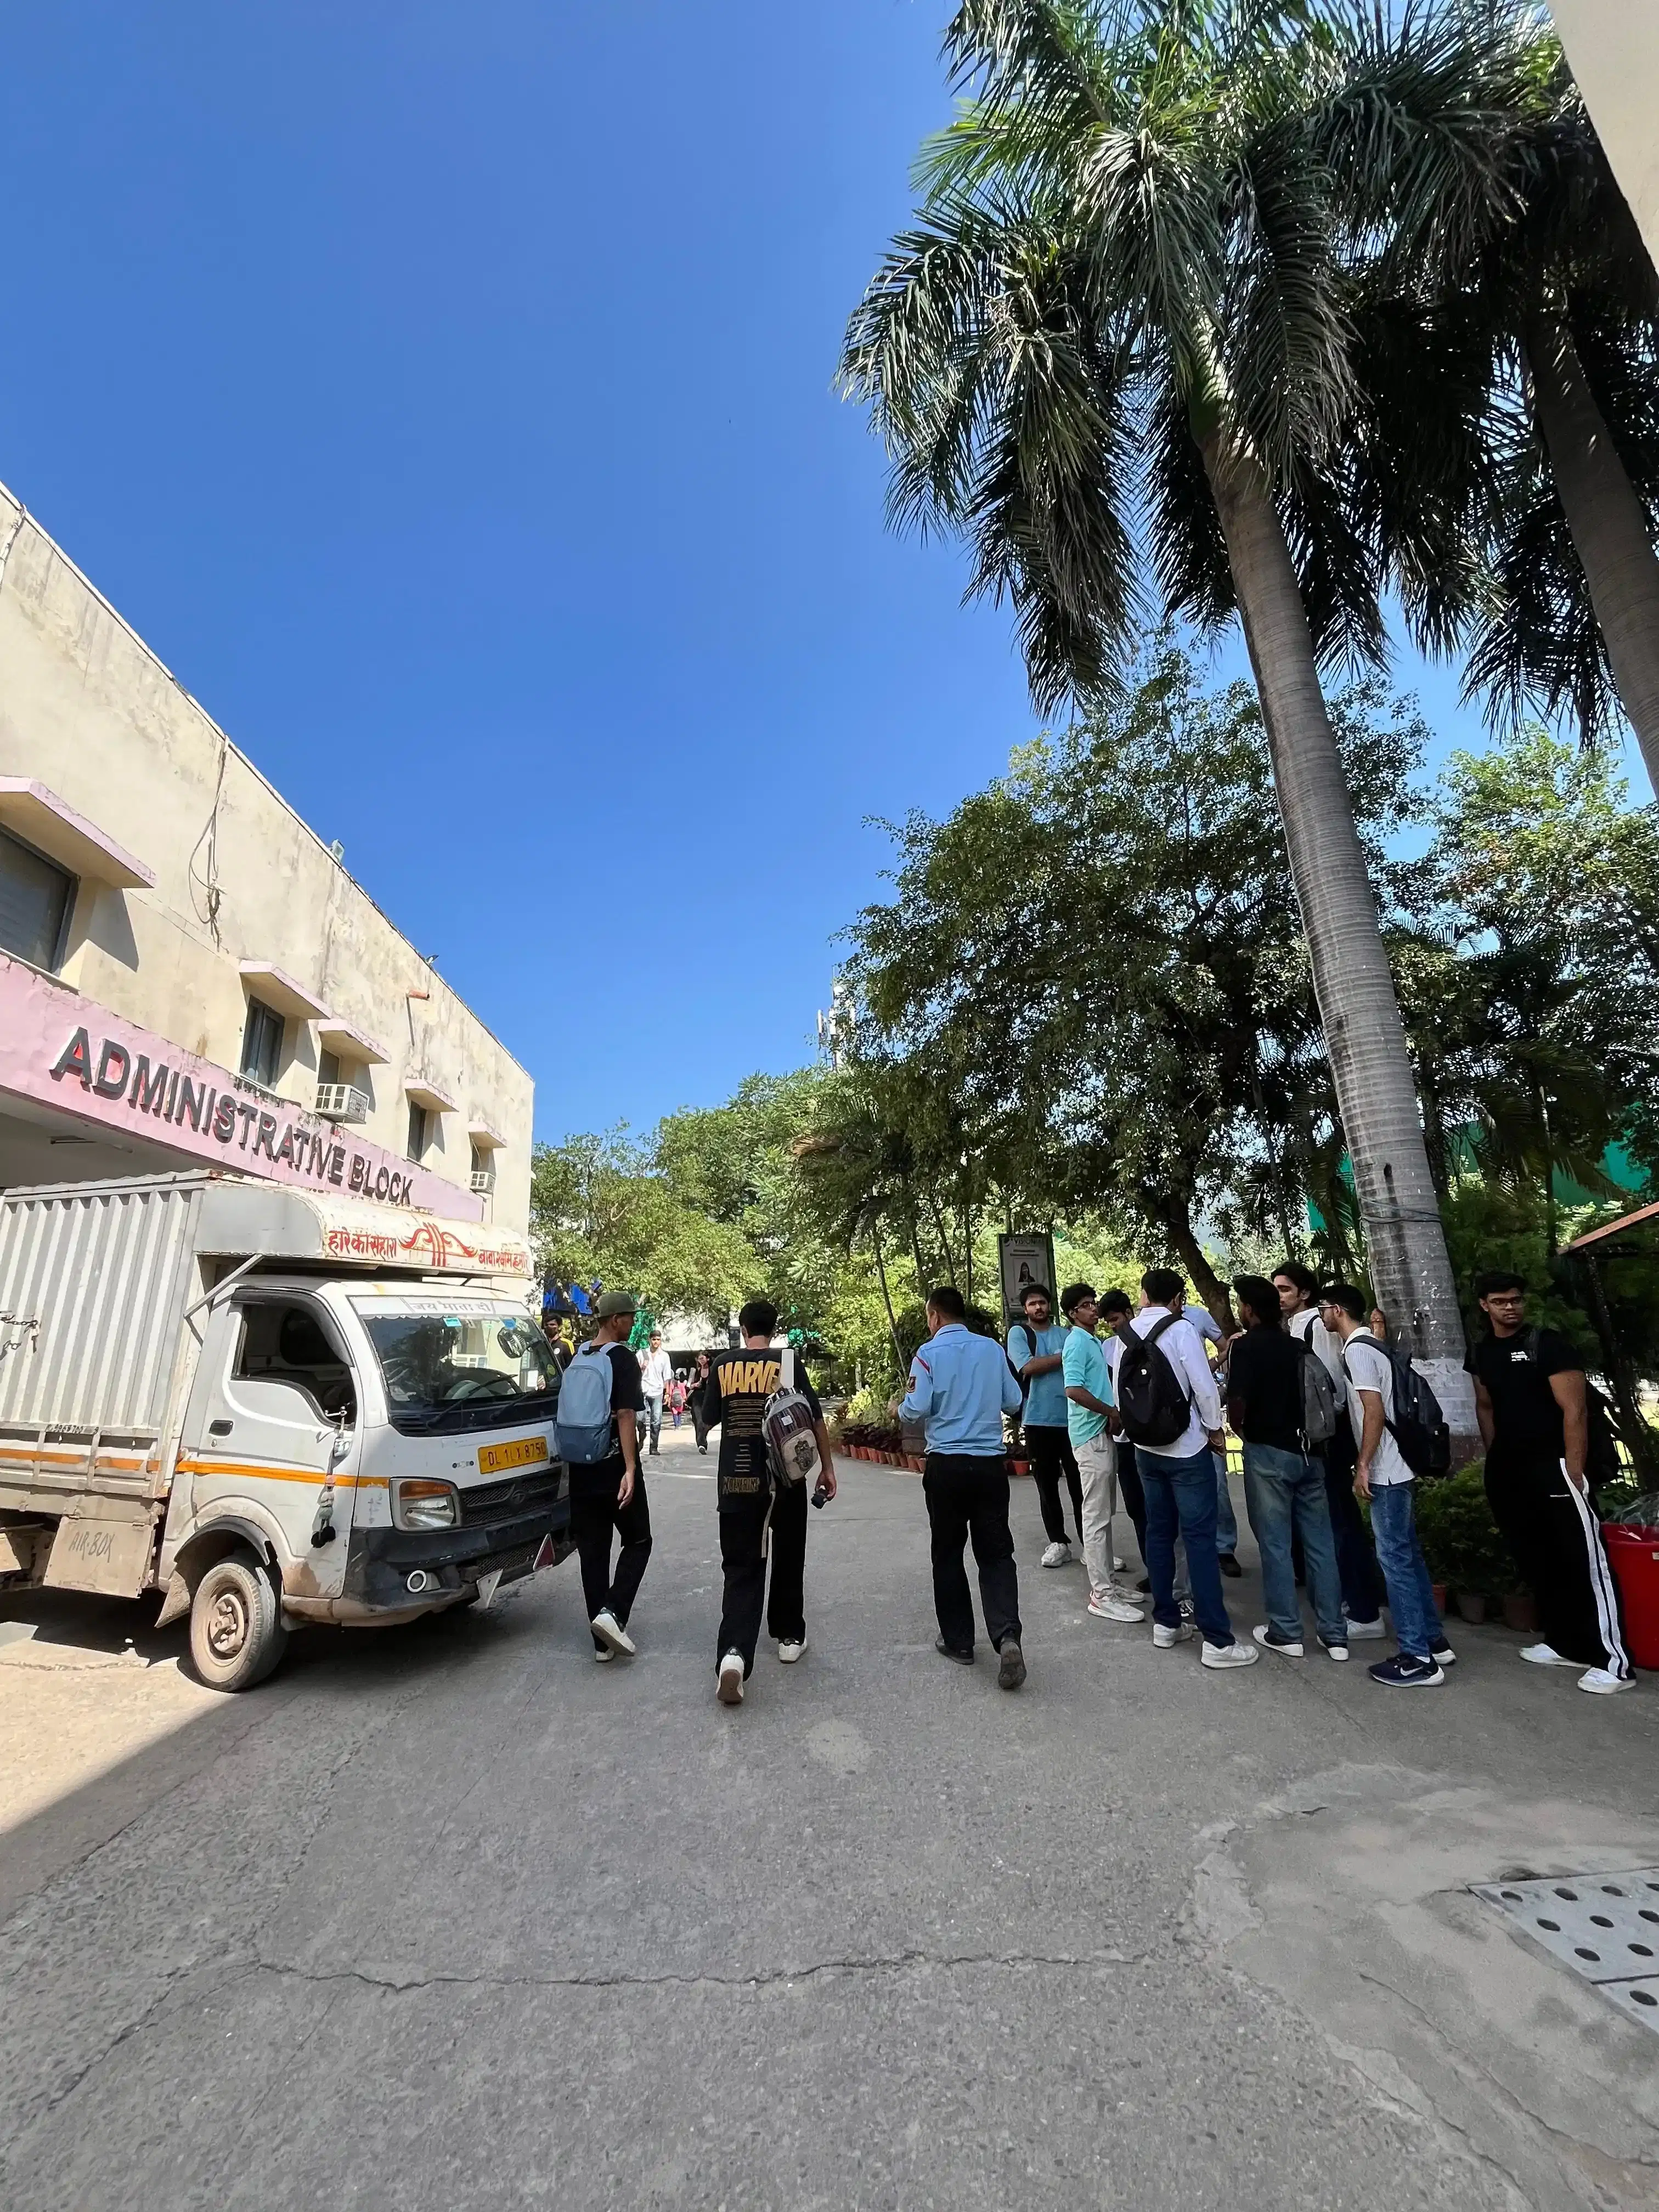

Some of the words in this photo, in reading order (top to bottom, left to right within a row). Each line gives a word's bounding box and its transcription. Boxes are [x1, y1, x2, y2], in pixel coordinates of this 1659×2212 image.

[49, 1026, 347, 1186] ADMINISTRATIVE
[348, 1154, 413, 1206] BLOCK
[329, 1226, 351, 1257] हारे
[352, 1233, 371, 1254] का
[410, 1302, 438, 1311] जय
[438, 1300, 474, 1312] माता
[487, 1451, 501, 1466] DL
